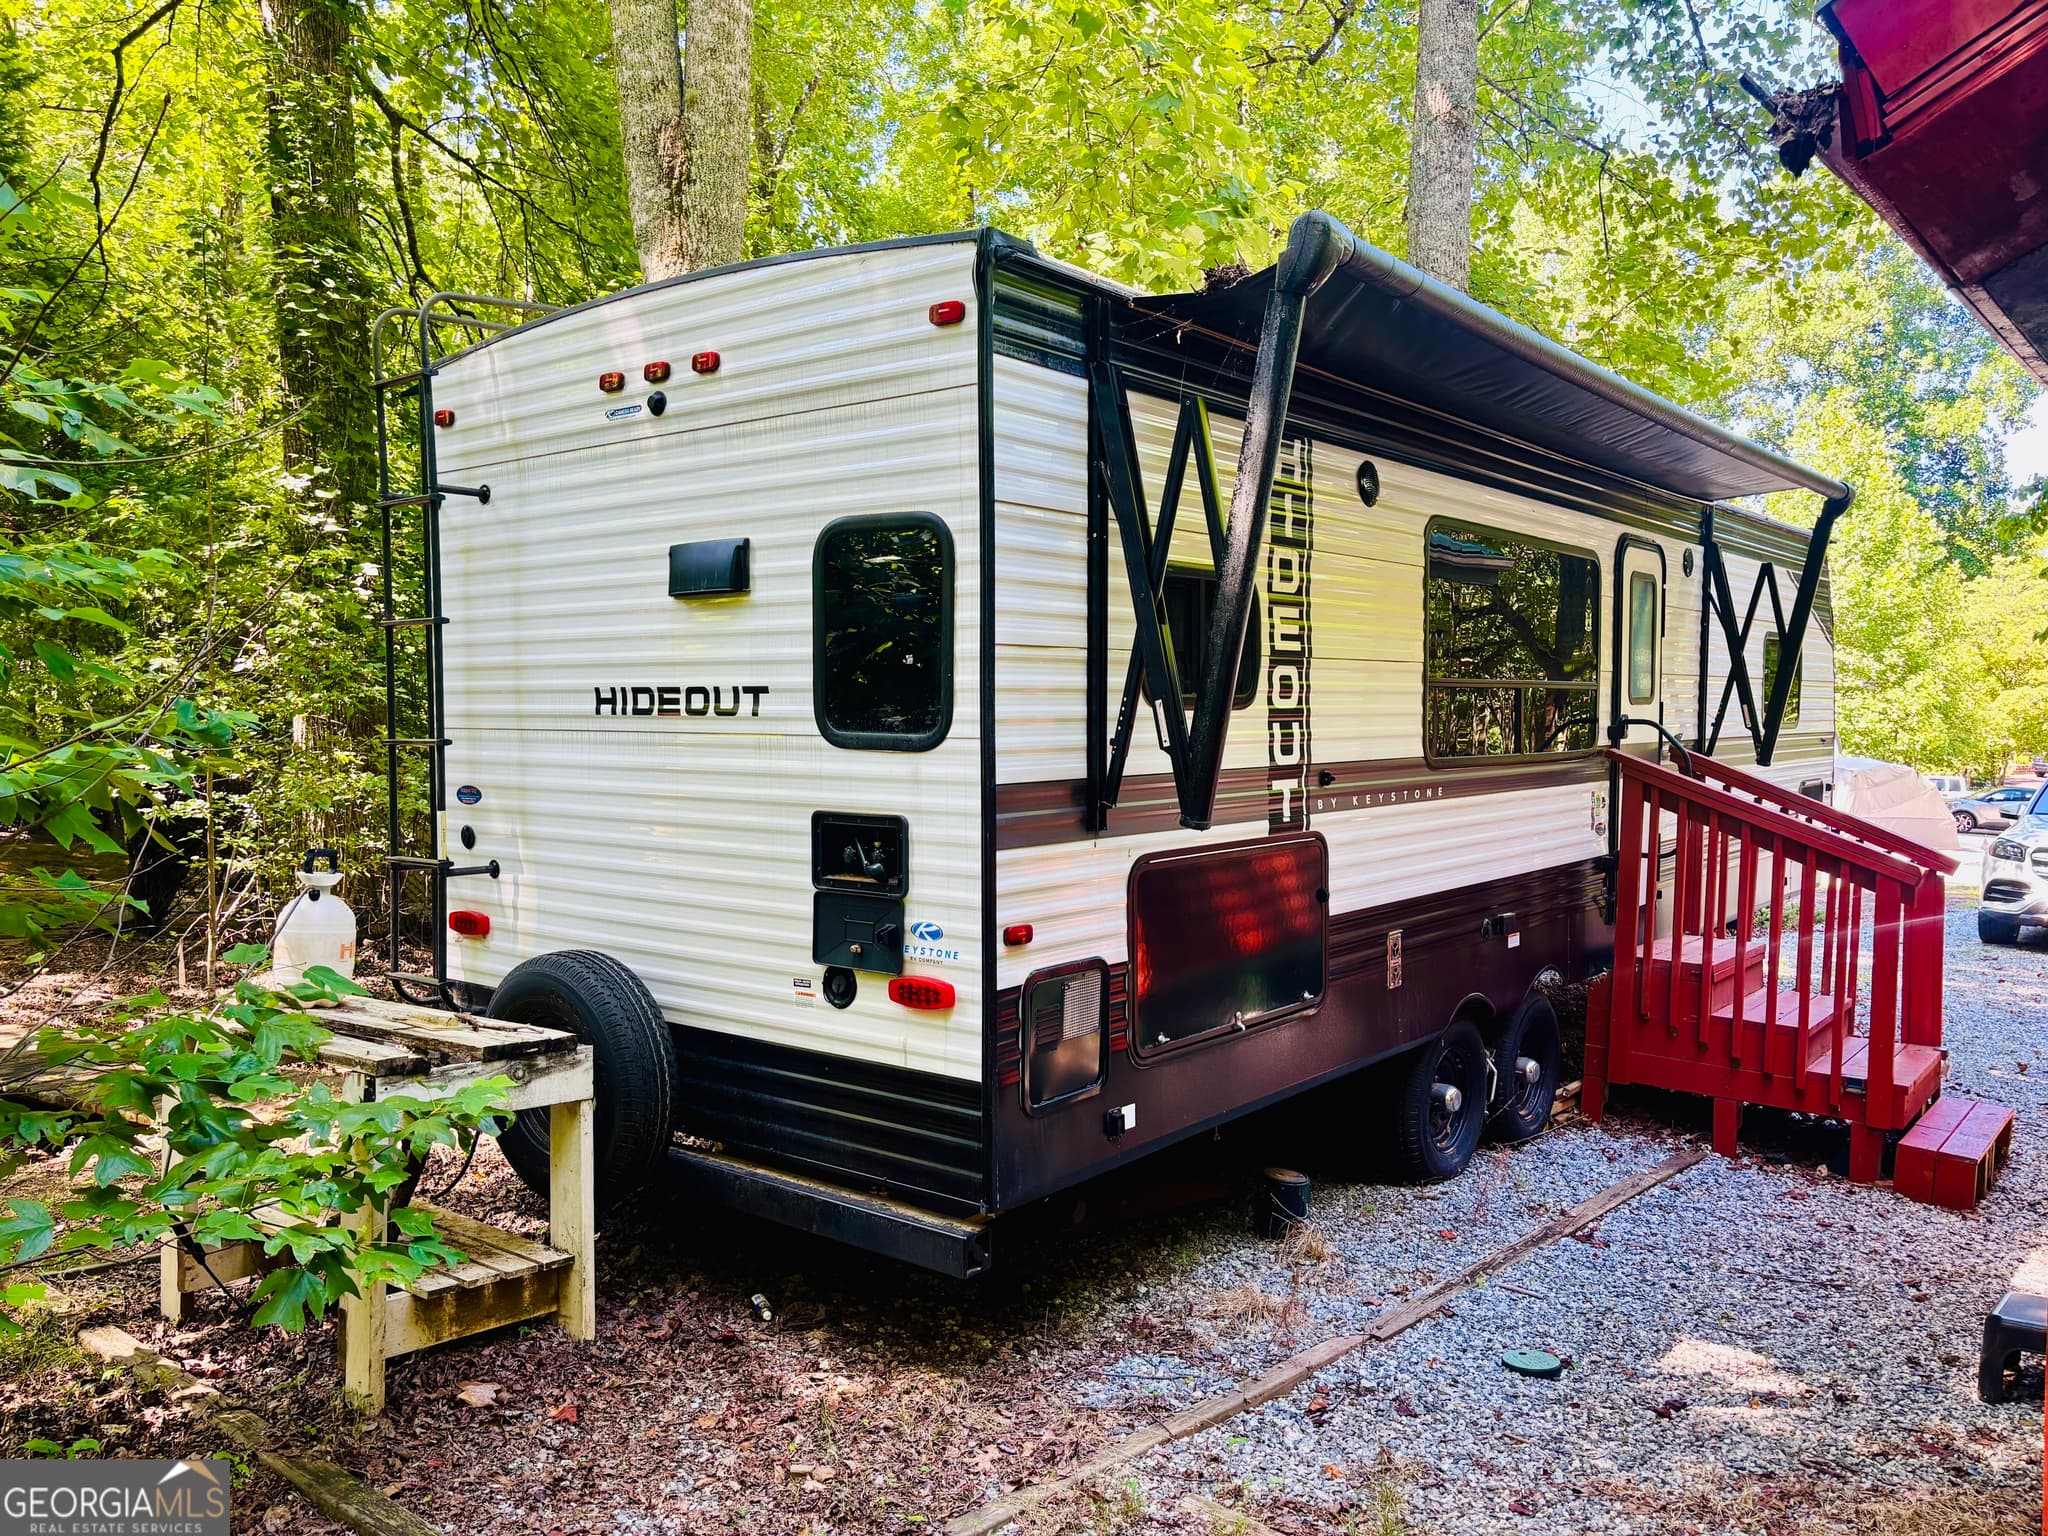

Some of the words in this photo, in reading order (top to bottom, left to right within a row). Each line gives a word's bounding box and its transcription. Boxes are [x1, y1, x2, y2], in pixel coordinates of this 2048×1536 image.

[1272, 438, 1302, 822] HIDEOUT
[594, 686, 770, 717] HIDEOUT
[1317, 798, 1337, 810] BY
[1352, 787, 1443, 807] KEYSTONE
[904, 944, 959, 960] EYSTONE
